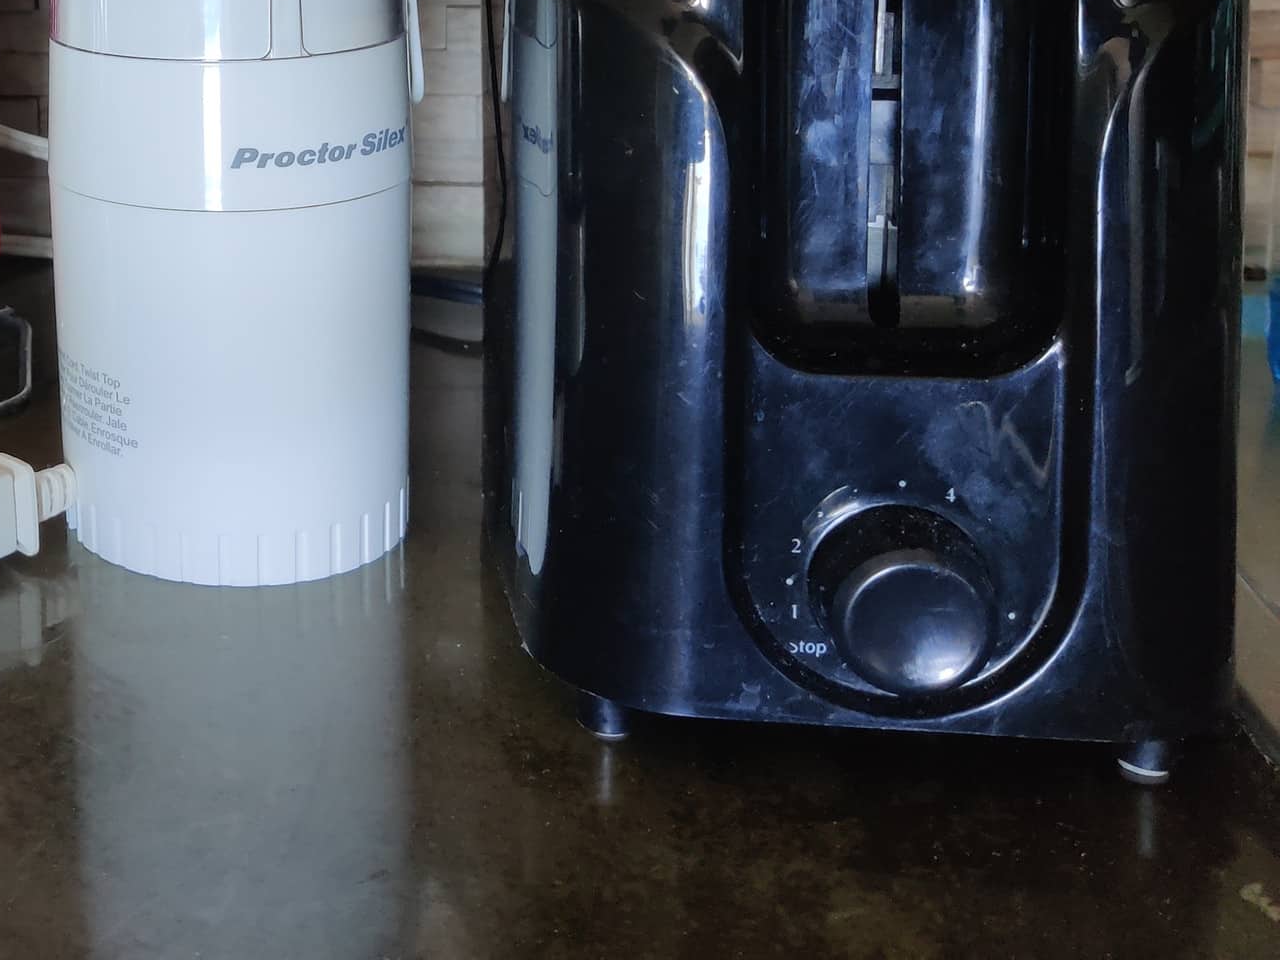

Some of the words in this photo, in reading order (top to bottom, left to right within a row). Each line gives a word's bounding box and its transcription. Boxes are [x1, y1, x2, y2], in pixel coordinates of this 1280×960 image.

[230, 142, 357, 169] Proctor
[360, 126, 407, 156] Silex
[102, 373, 121, 390] Top
[95, 397, 123, 417] Partie
[116, 392, 131, 405] Le
[106, 416, 128, 432] Jale
[91, 423, 139, 448] Enrosque
[944, 487, 957, 504] 4
[791, 538, 802, 554] 2
[791, 604, 798, 619] 1
